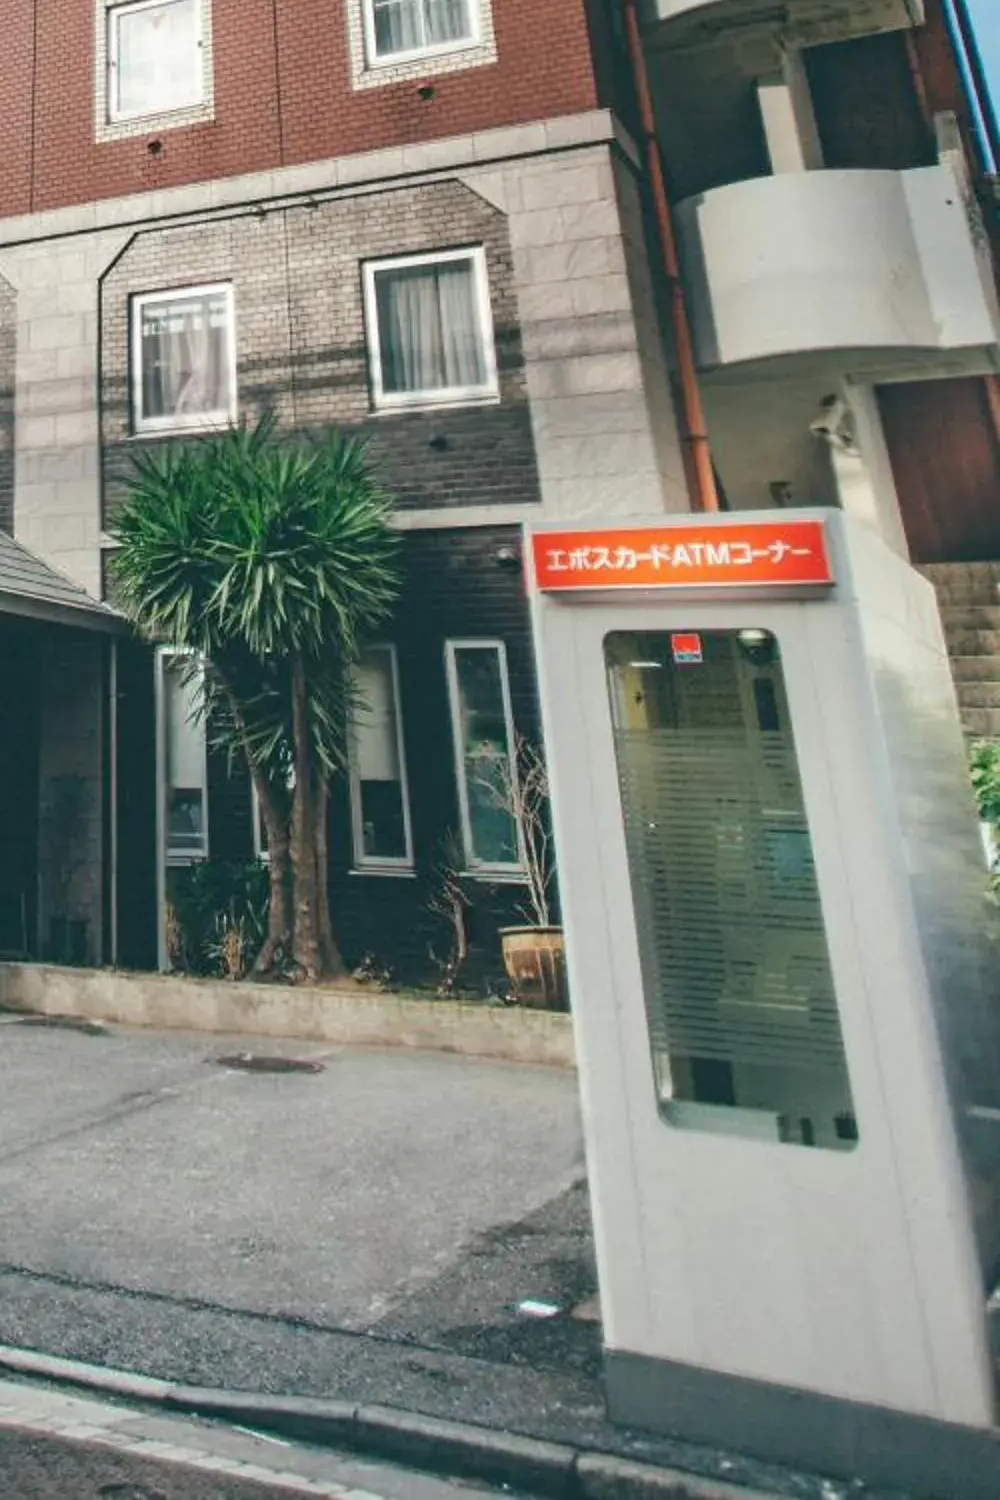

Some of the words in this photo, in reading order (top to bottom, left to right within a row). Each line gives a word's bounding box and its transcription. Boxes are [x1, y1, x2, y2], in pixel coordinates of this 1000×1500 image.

[546, 540, 811, 572] エポスカードATMコーナー
